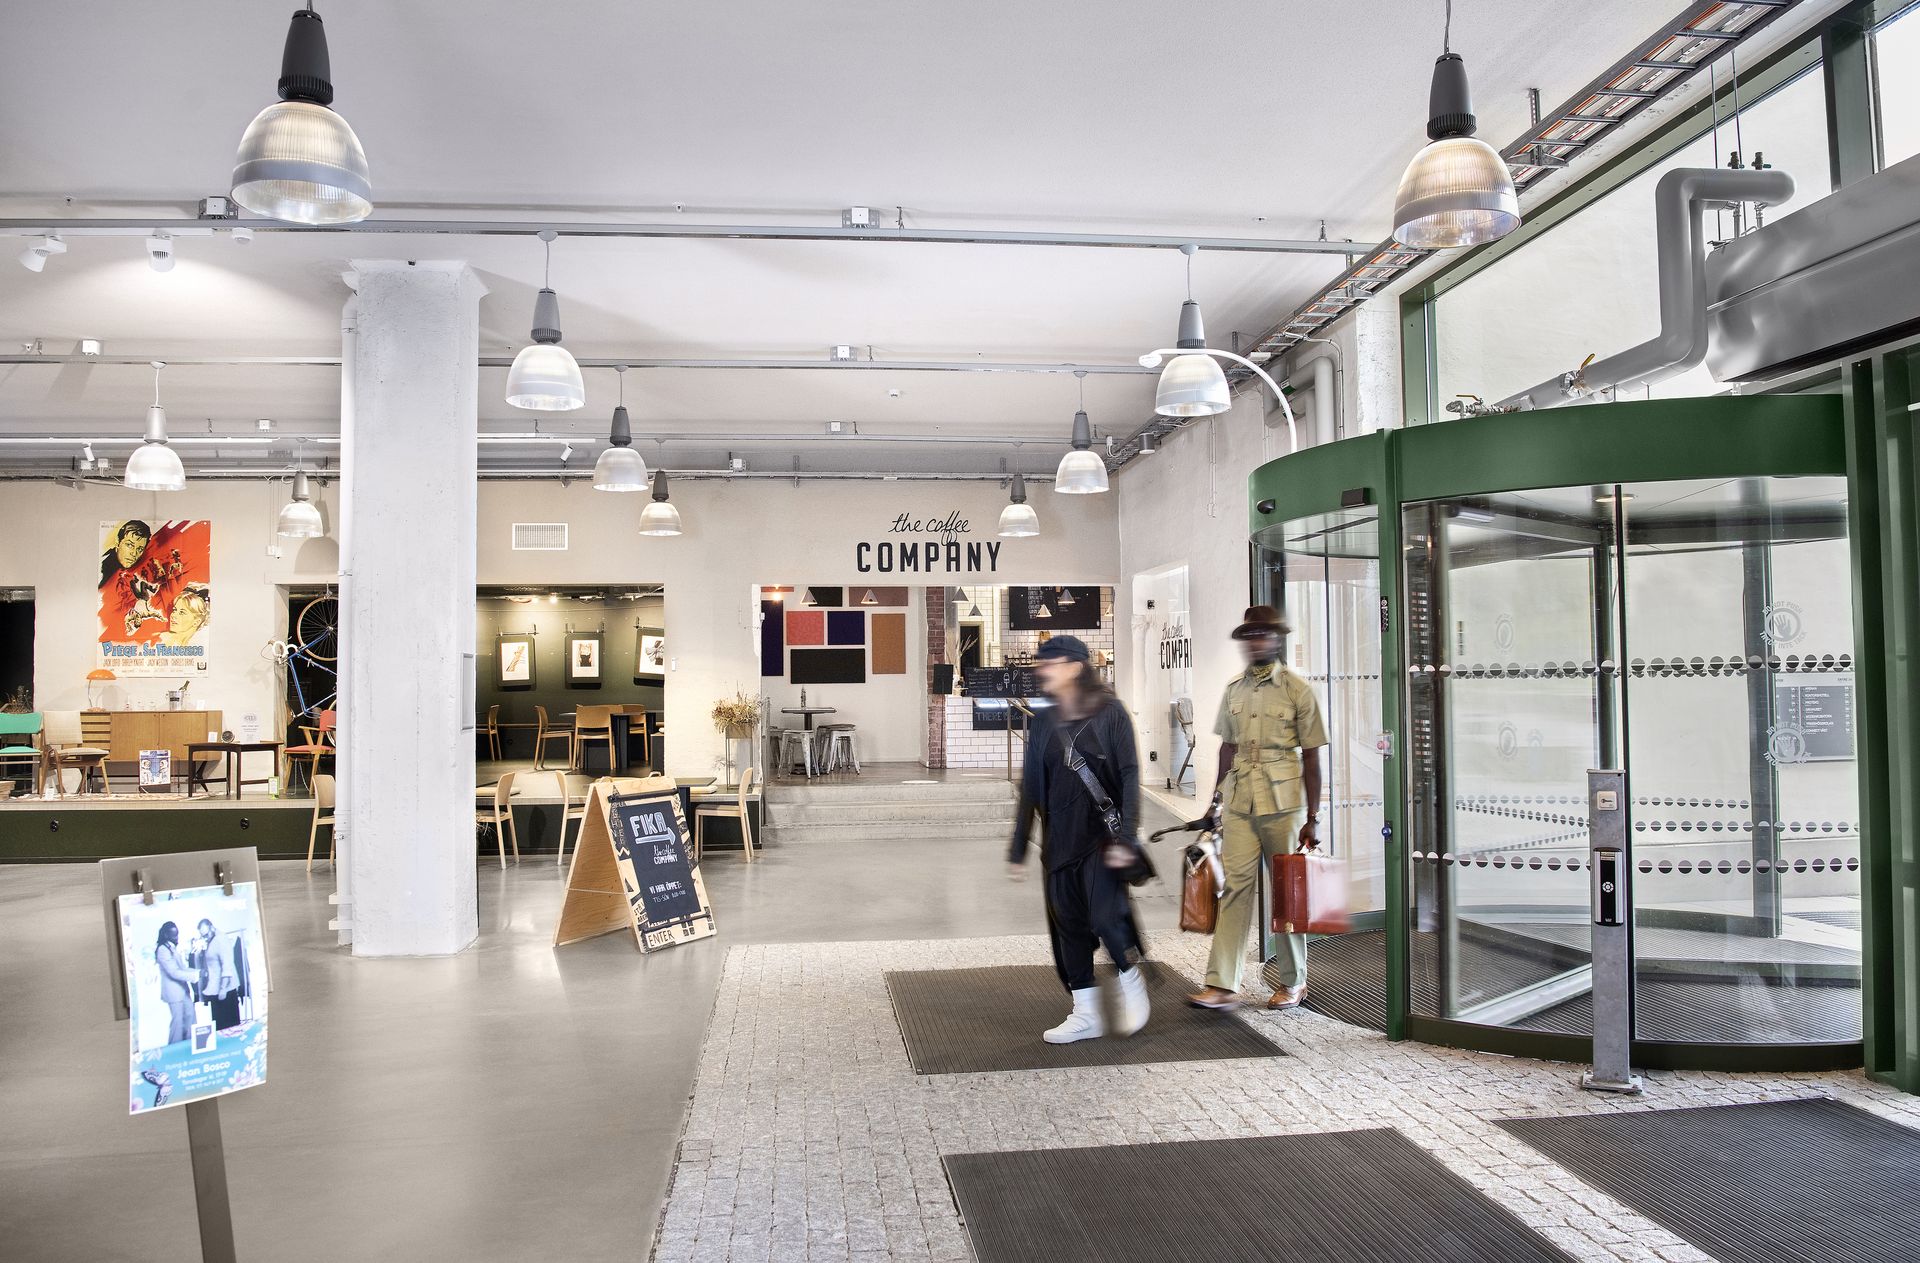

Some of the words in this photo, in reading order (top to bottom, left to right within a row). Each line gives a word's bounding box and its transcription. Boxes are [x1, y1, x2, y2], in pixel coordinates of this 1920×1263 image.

[888, 512, 924, 533] the
[925, 510, 971, 547] coffee
[856, 541, 1002, 573] COMPANY
[156, 643, 204, 656] FRANCISCO
[630, 812, 667, 837] FIKA
[653, 854, 678, 865] COMPANY
[655, 883, 667, 893] HAR
[648, 930, 675, 947] ENTER
[177, 1069, 200, 1079] Jean
[203, 1061, 230, 1073] Bosco
